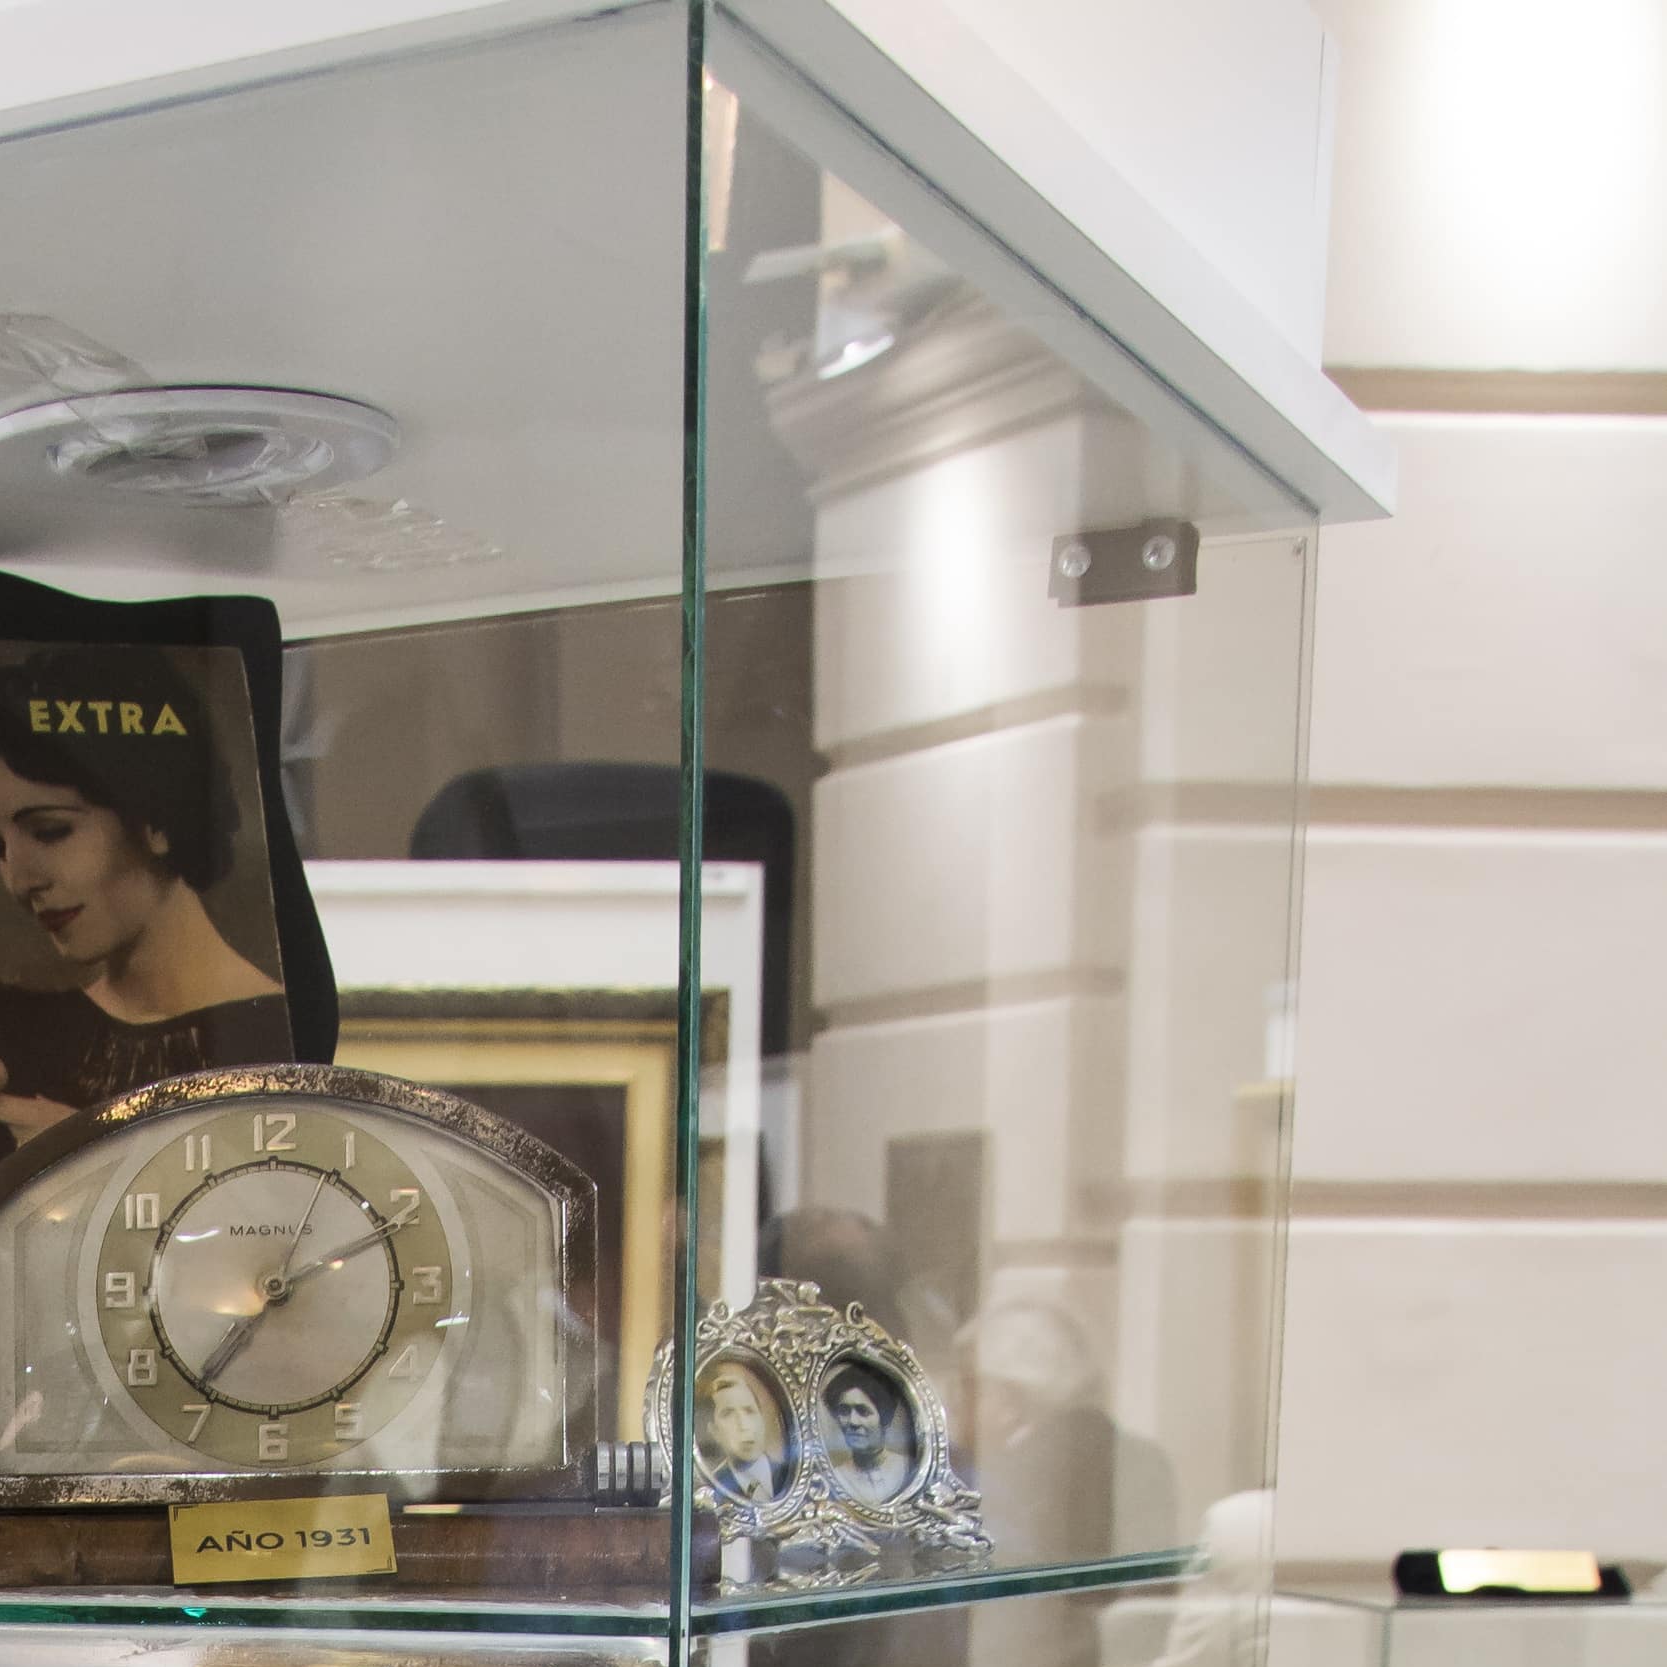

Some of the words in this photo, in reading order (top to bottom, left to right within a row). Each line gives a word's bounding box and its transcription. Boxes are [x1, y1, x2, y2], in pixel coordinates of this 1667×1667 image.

[30, 699, 188, 737] EXTRA
[253, 1113, 297, 1152] 12
[344, 1132, 356, 1168] 1
[184, 1135, 212, 1171] 11
[125, 1193, 160, 1229] 10
[389, 1188, 421, 1226] 2
[229, 1223, 313, 1237] MAGNUS
[105, 1271, 135, 1309] 9
[413, 1266, 443, 1305] 3
[128, 1348, 159, 1386] 8
[389, 1344, 423, 1383] 4
[182, 1402, 212, 1443] 7
[335, 1402, 365, 1441] 5
[258, 1424, 289, 1462] 6
[196, 1527, 285, 1555] AÑO
[297, 1526, 372, 1550] 1931
